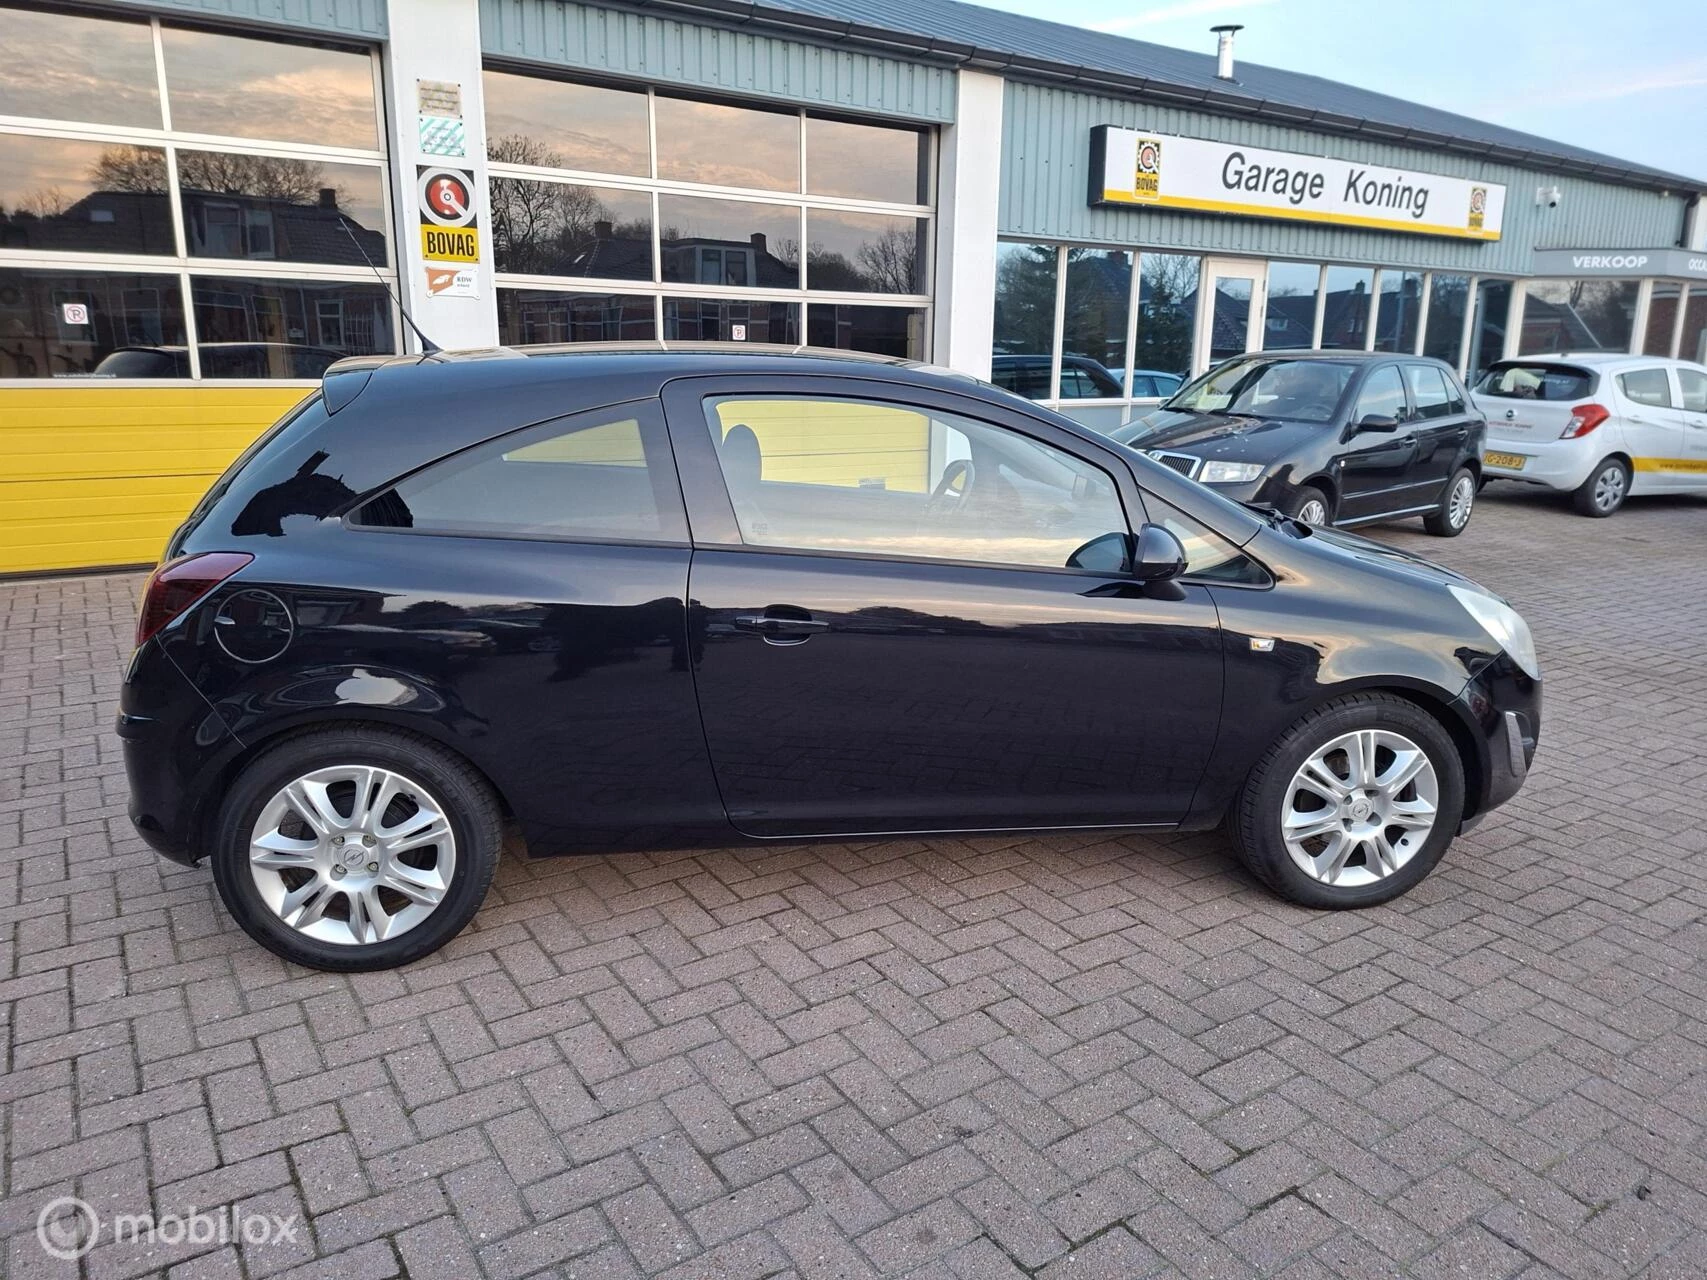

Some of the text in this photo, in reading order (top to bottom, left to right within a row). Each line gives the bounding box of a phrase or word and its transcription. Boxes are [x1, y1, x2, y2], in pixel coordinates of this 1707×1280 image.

[1136, 177, 1158, 192] BOVAG
[1222, 151, 1429, 219] Garage Koning
[426, 231, 475, 257] BOVAG
[1572, 255, 1648, 269] VERKOOP
